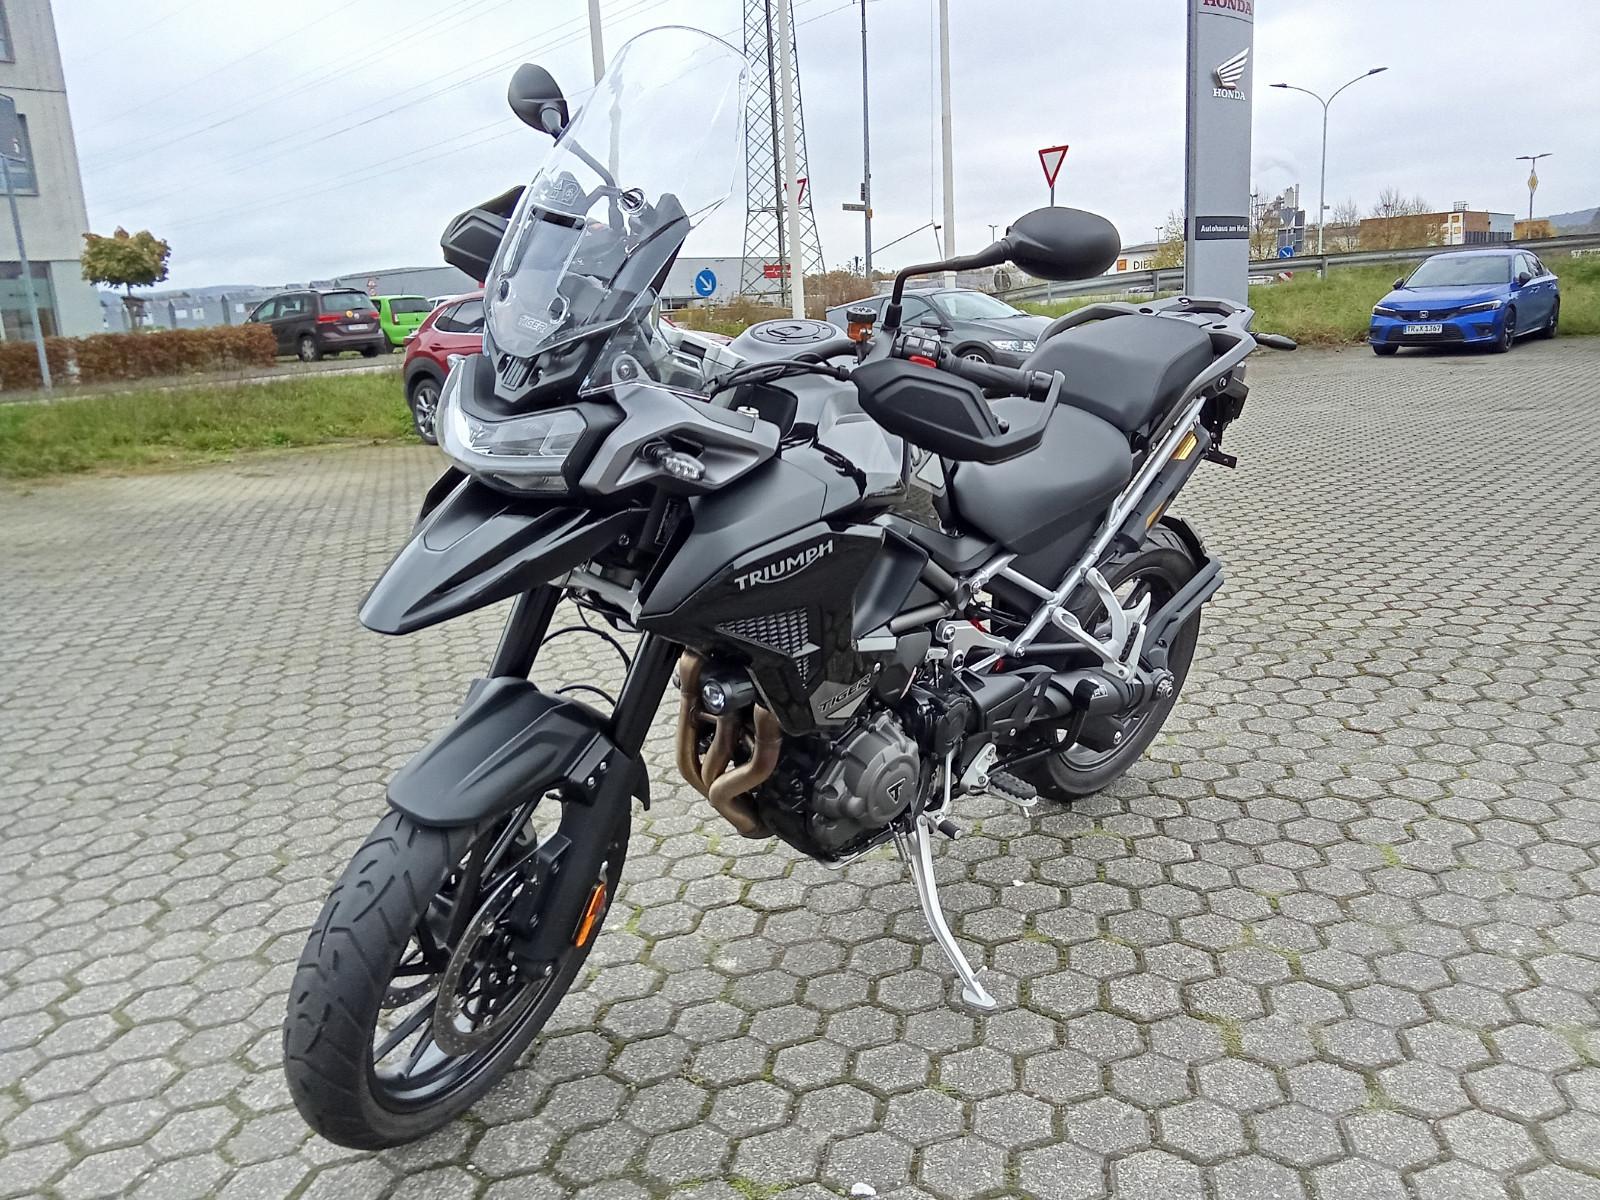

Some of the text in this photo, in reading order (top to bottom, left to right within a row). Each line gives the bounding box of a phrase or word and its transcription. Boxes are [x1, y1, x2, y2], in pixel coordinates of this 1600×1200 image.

[1203, 0, 1252, 15] HONDA
[1213, 88, 1246, 100] HONDA
[1201, 224, 1228, 233] Autohaus
[519, 315, 547, 333] TIGER
[734, 539, 833, 590] TRIUMPH
[818, 673, 871, 713] TIGER
